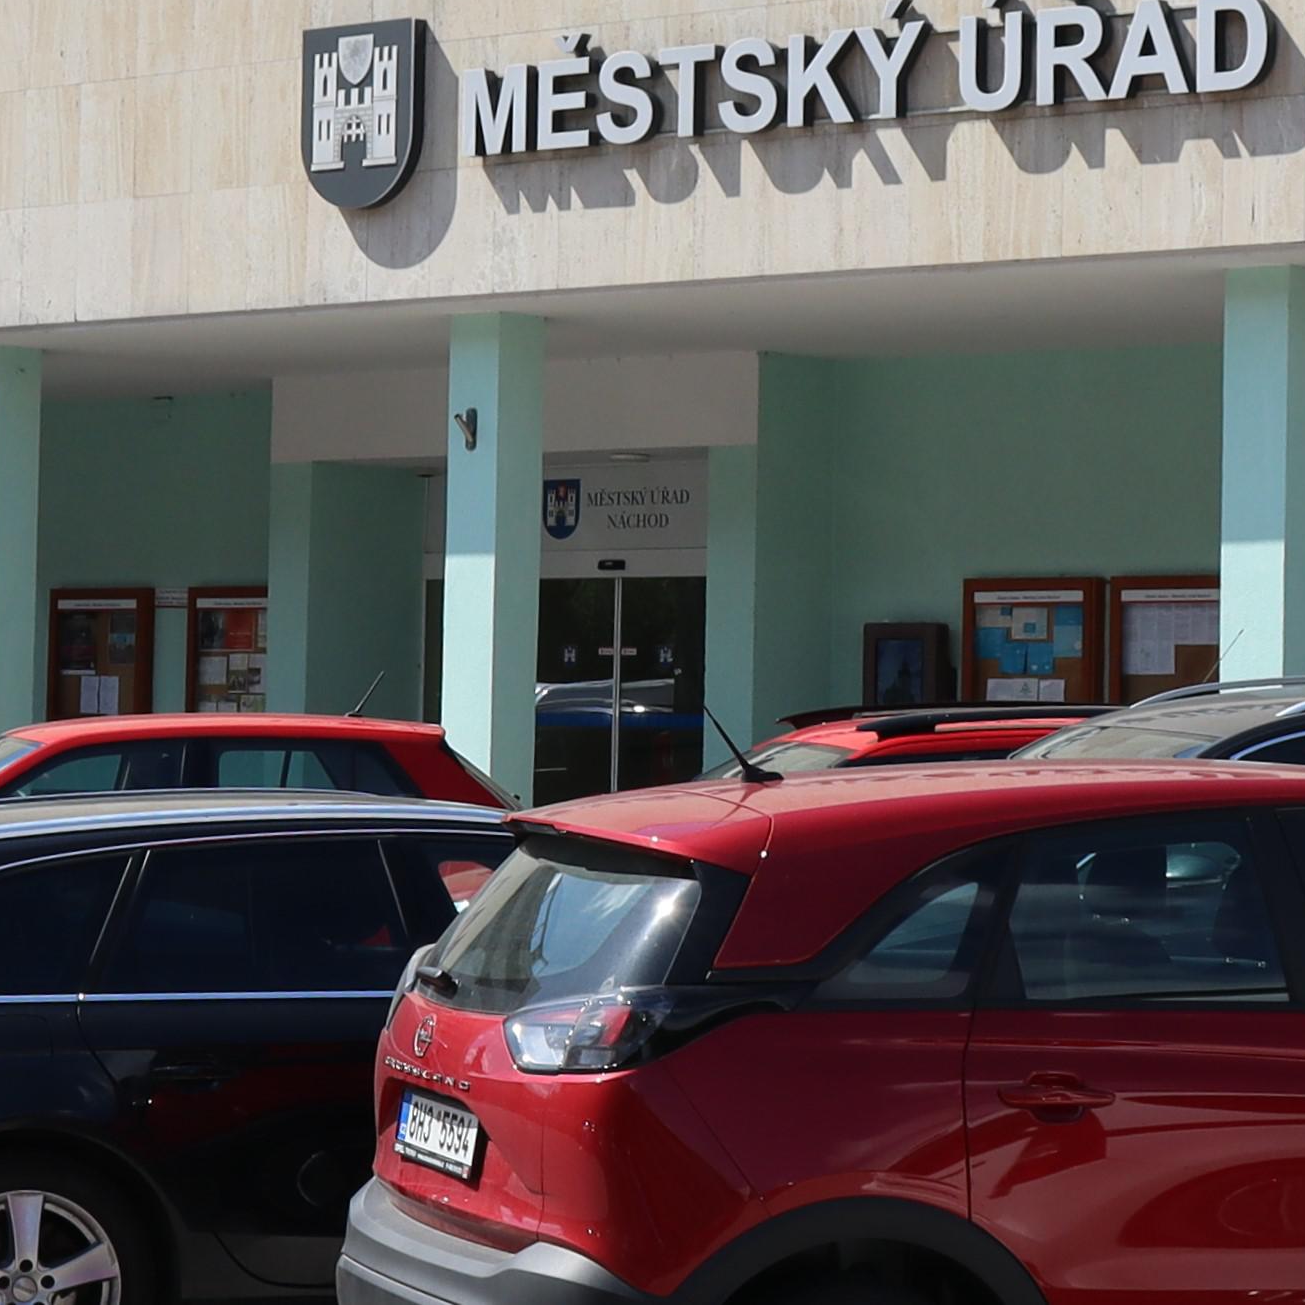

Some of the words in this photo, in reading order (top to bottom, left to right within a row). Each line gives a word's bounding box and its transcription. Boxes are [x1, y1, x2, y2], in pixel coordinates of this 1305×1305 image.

[587, 486, 647, 507] MĚSTSKÝ
[650, 485, 691, 505] ÚŘAD
[606, 510, 670, 530] NÁCHOD
[438, 1109, 473, 1158] 5594
